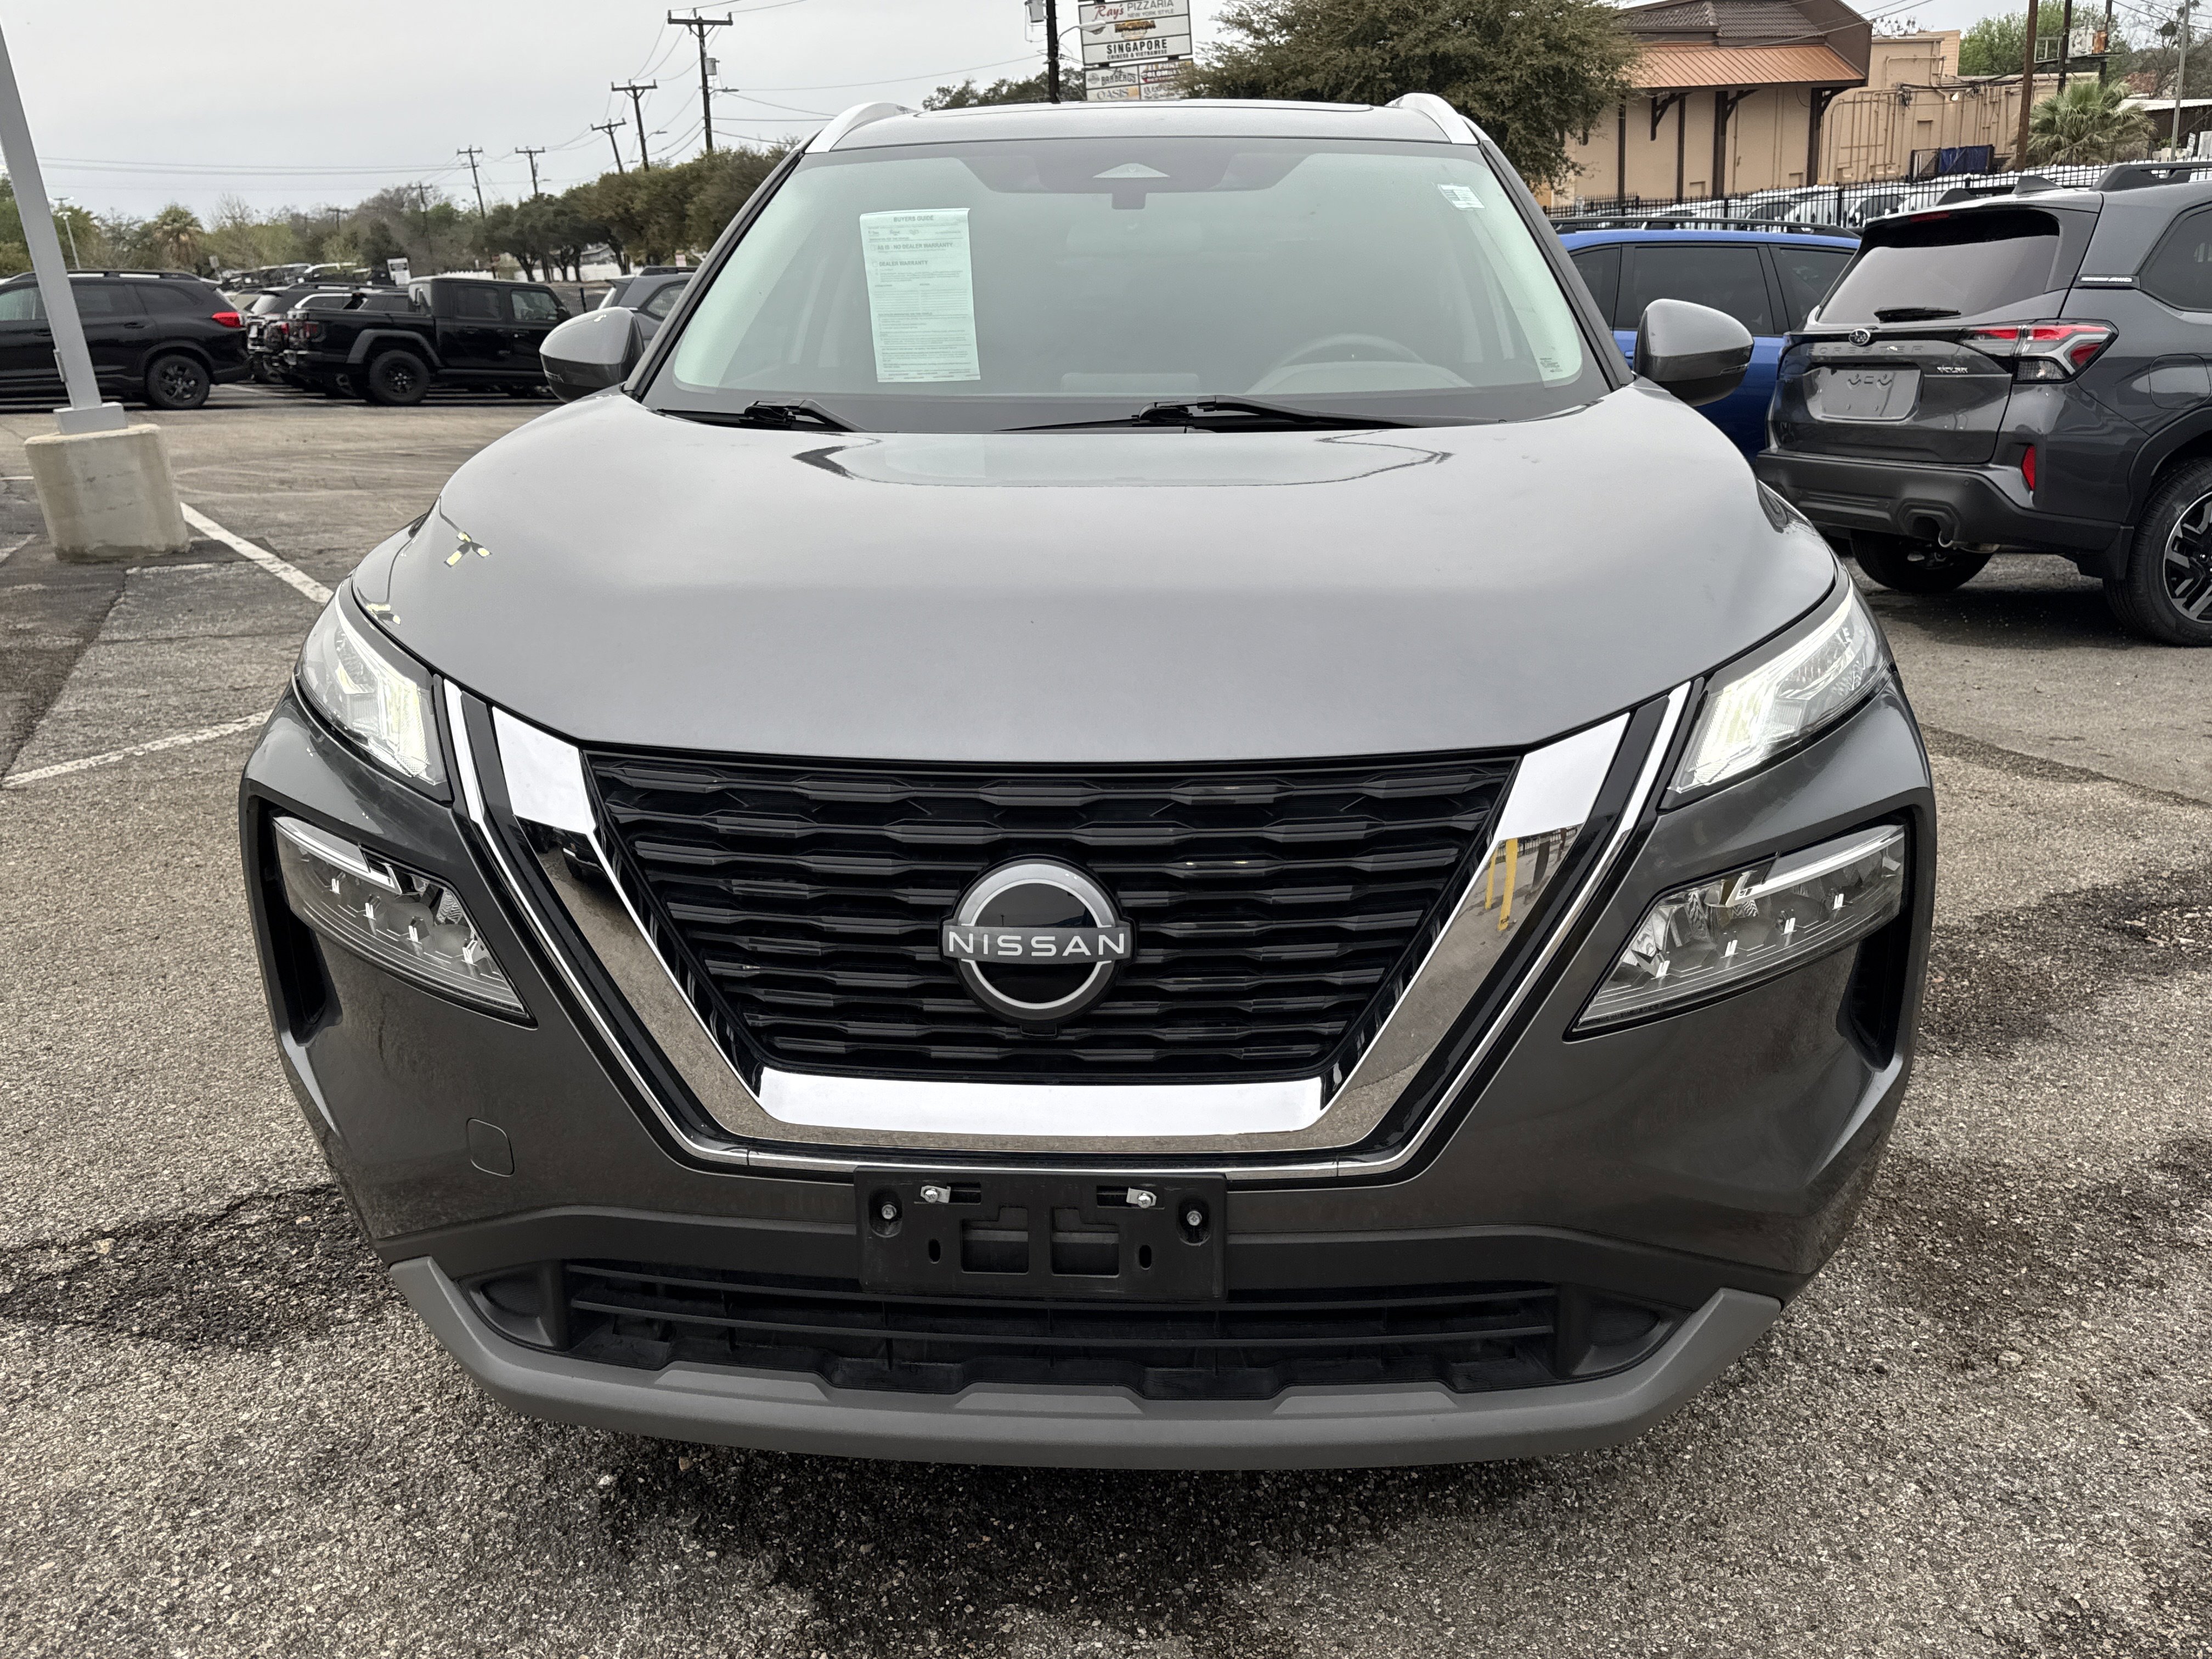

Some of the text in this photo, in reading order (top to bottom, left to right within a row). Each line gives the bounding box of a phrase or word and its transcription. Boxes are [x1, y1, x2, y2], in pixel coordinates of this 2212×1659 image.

[1092, 0, 1174, 21] Ray's PIZZARIA
[1107, 39, 1167, 54] SINGAPORE
[1807, 345, 1923, 356] FORESTER
[949, 931, 1124, 957] NISSAN
